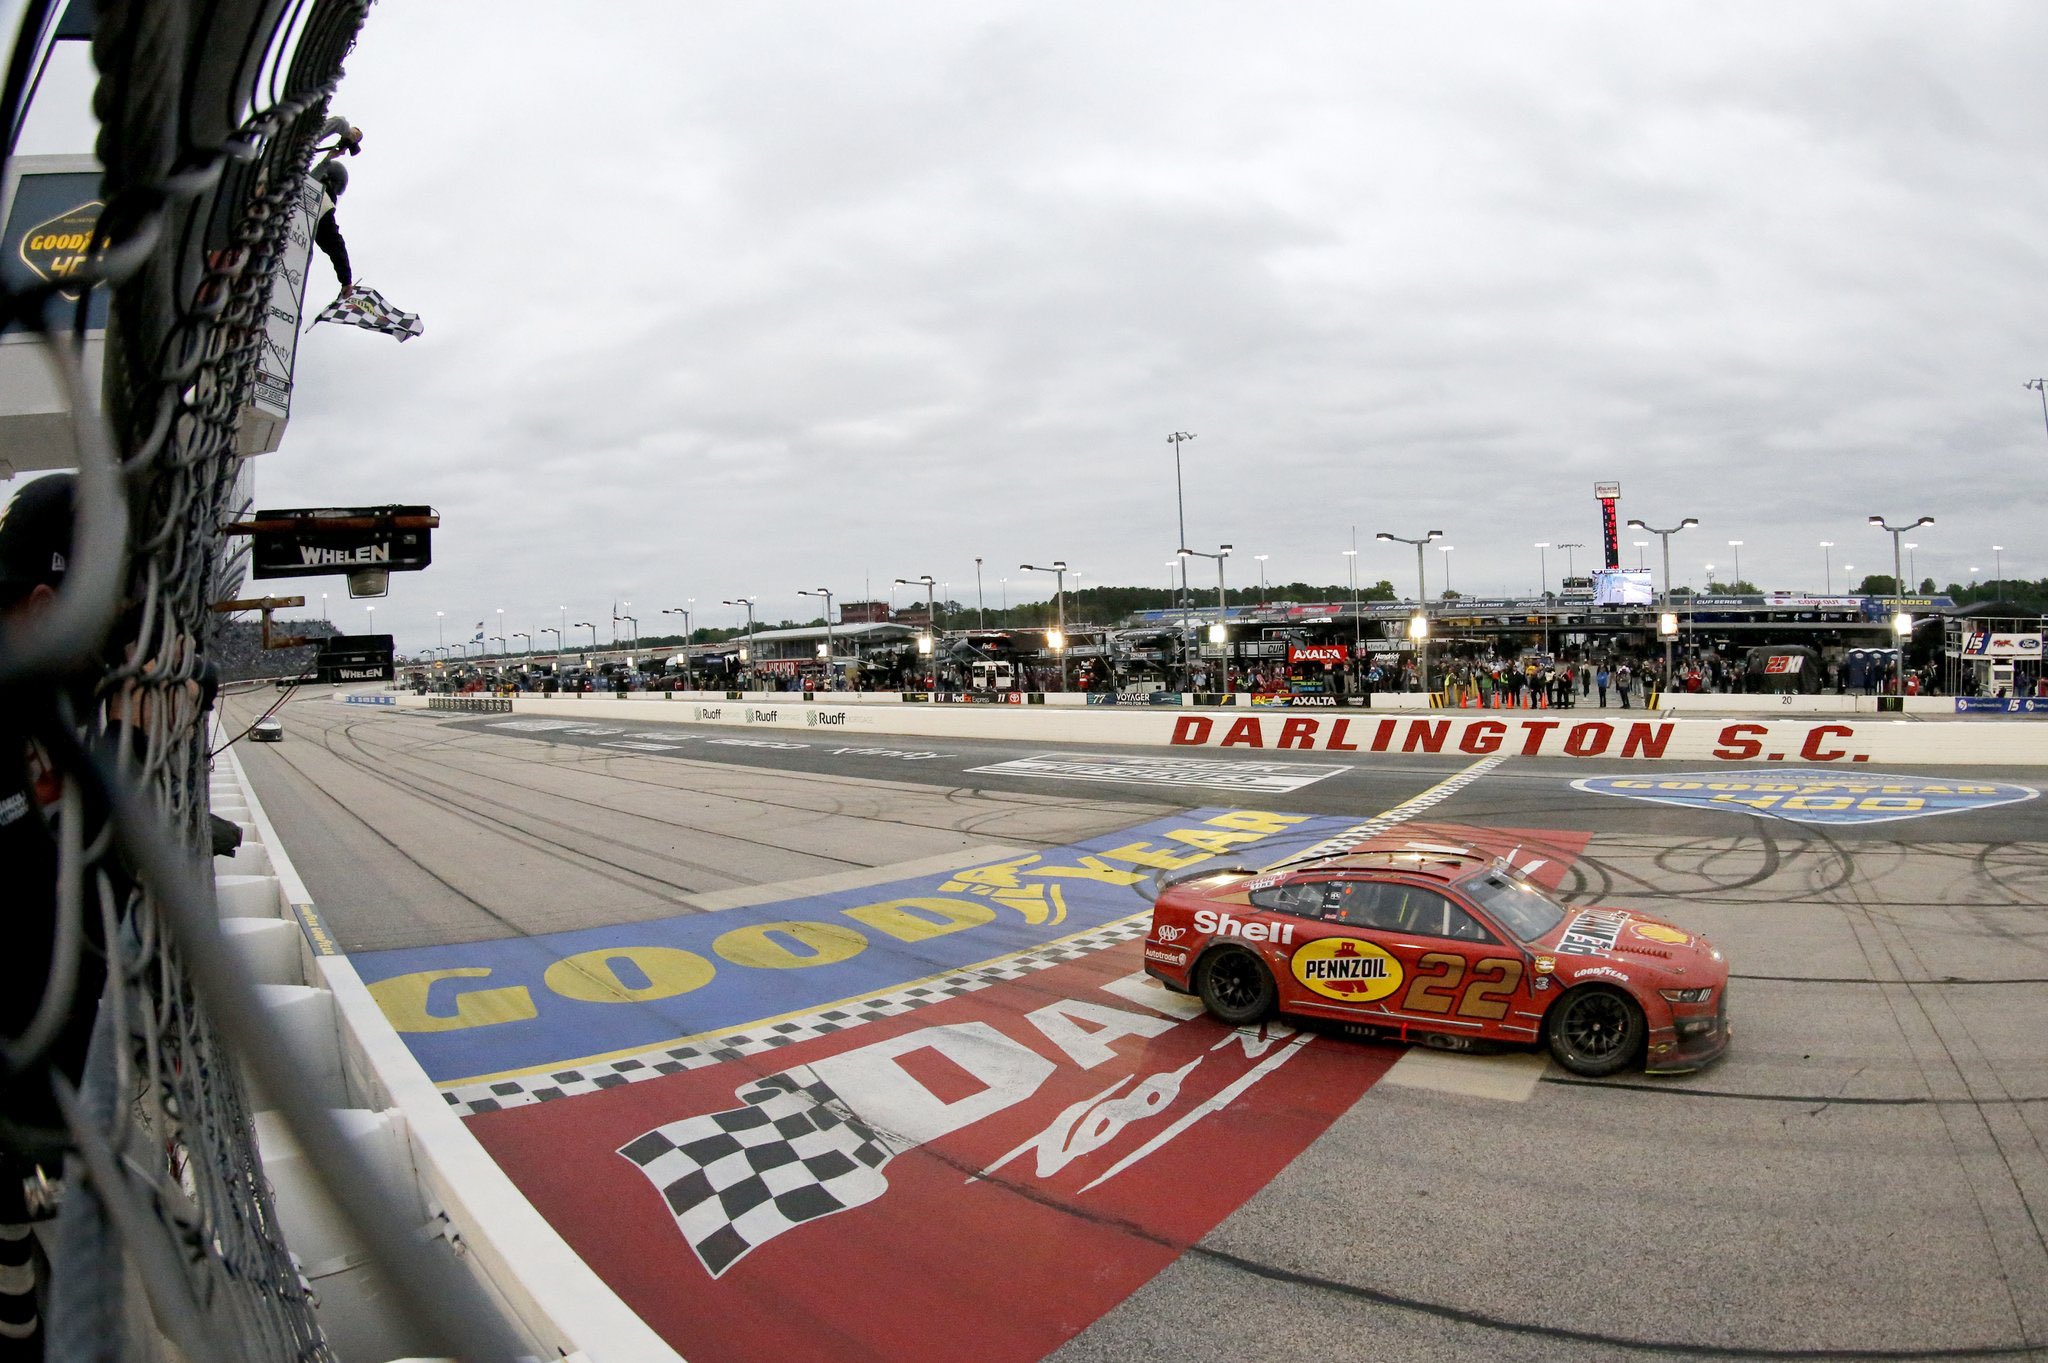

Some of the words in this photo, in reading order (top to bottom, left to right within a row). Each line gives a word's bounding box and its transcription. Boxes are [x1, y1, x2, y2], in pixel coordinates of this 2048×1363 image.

[300, 542, 389, 565] WHELEN
[1267, 644, 1285, 653] CUP
[1969, 637, 1983, 649] 15
[2021, 639, 2038, 649] Ford
[1293, 649, 1341, 660] AXALTA
[1764, 656, 1804, 674] 23XI
[340, 666, 383, 679] WHELEN
[937, 693, 945, 702] 11
[952, 693, 972, 703] FedEx
[997, 694, 1006, 703] 11
[1093, 694, 1106, 704] 77
[1116, 693, 1150, 701] VOYAGER
[1292, 696, 1337, 706] AXALTA
[1782, 696, 1792, 705] 20
[2007, 699, 2020, 711] 15
[702, 708, 721, 720] Ruoff
[755, 709, 778, 722] Ruoff
[818, 711, 846, 725] Ruoff
[1171, 716, 1675, 759] DARLINGTON
[1712, 724, 1869, 763] S.C.
[823, 747, 957, 761] xfinity
[1610, 780, 1998, 795] GOODYEAR
[1708, 794, 1926, 811] 400
[1253, 881, 1272, 889] TIRE
[369, 811, 1311, 1033] GOODYEAR
[1193, 910, 1295, 945] Shell
[1145, 948, 1179, 963] Autotrader
[1305, 958, 1387, 979] PENNZOIL
[1574, 966, 1629, 982] GOODYEAR
[1402, 952, 1523, 1020] 22
